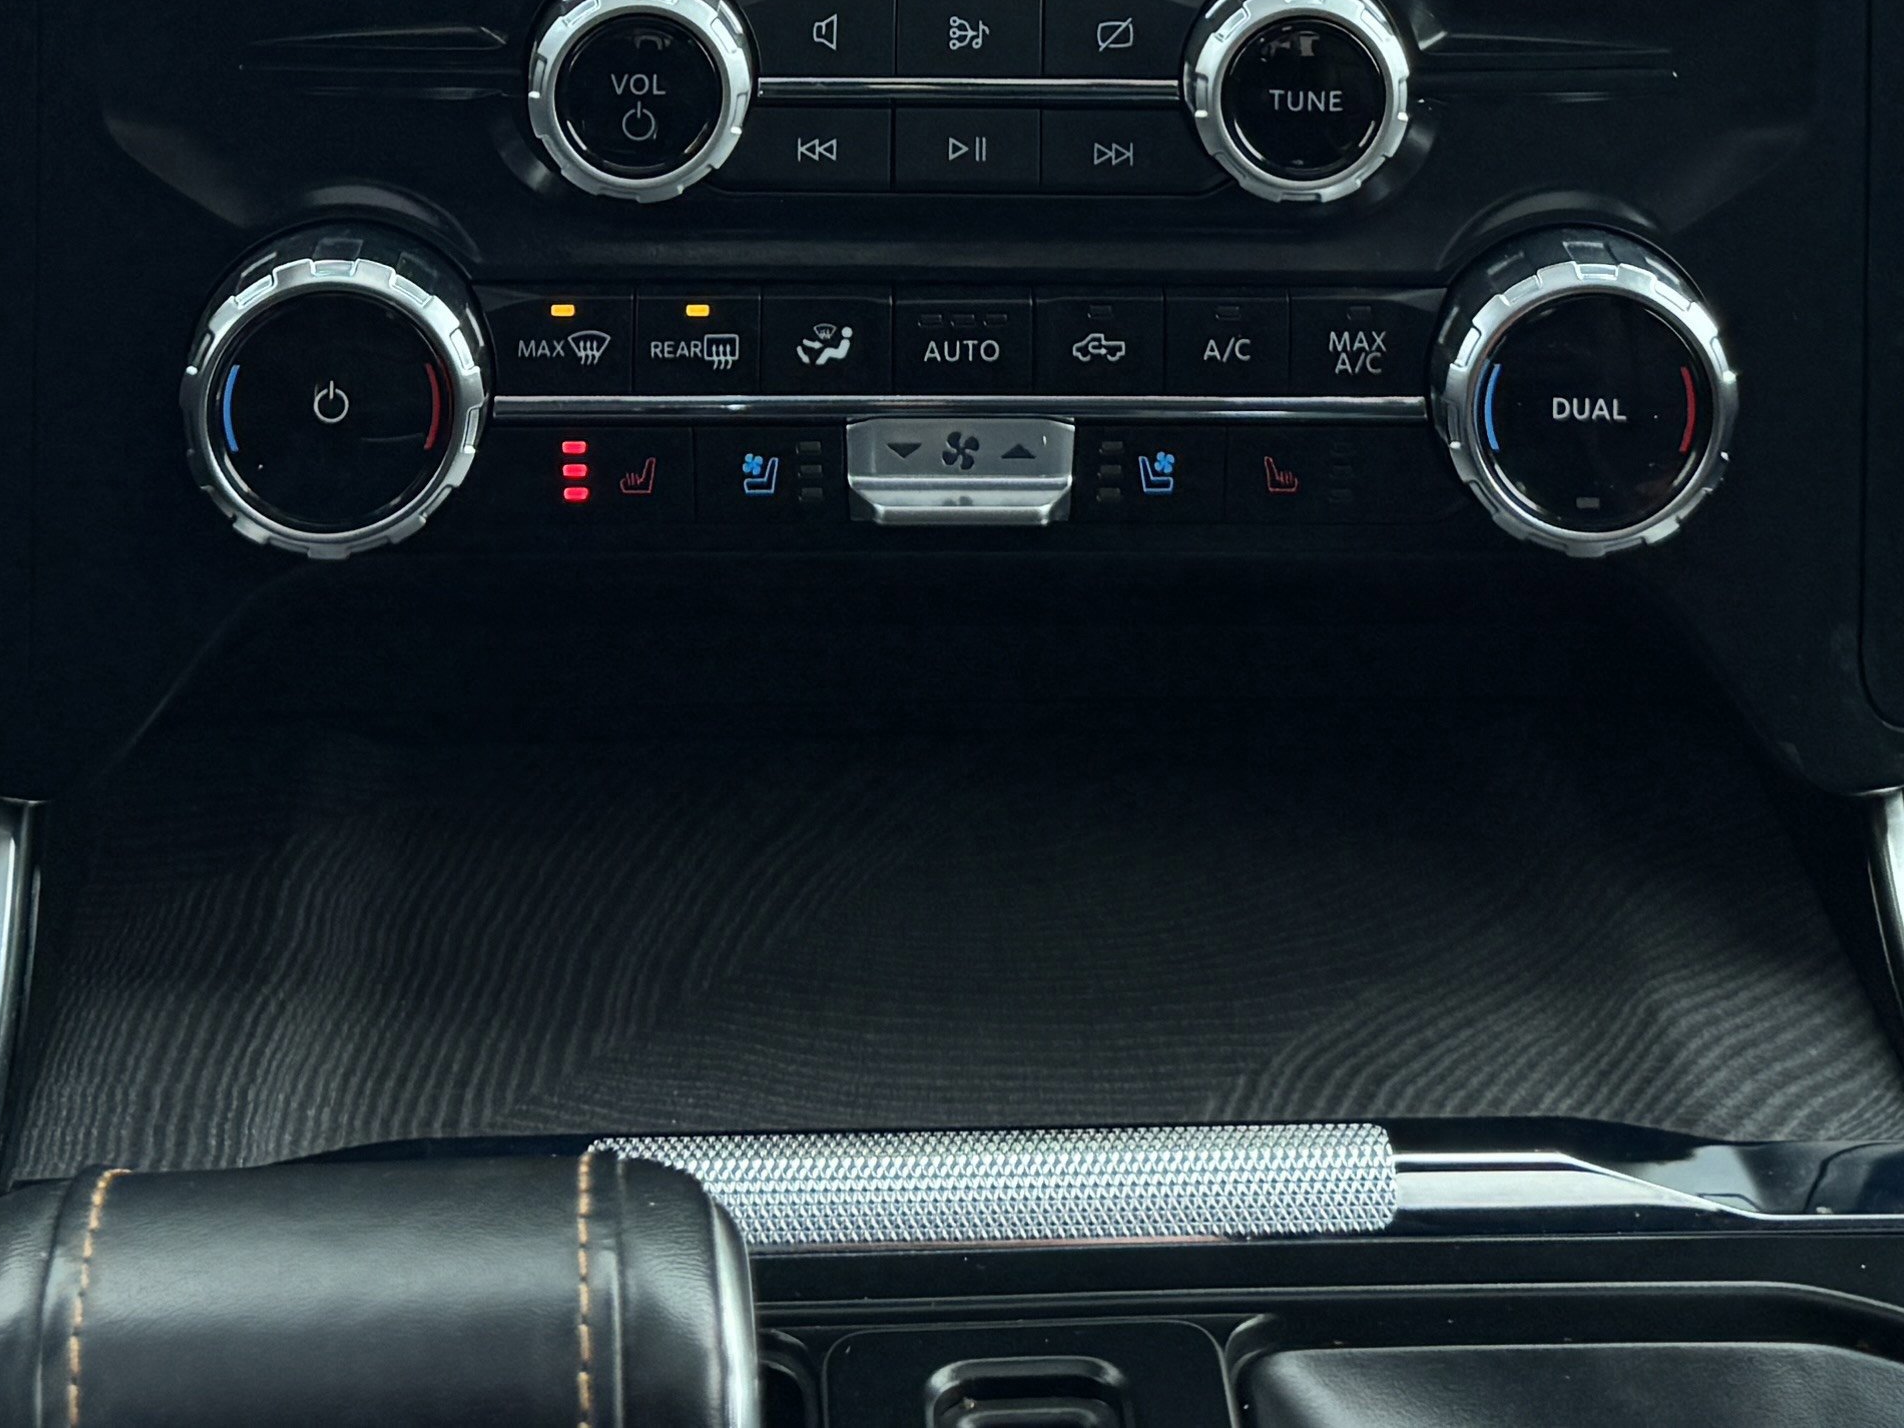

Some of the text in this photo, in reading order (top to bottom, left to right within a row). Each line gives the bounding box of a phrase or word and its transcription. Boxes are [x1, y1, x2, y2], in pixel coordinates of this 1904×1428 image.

[611, 74, 666, 97] VOL
[1269, 89, 1343, 113] TUNE
[518, 340, 565, 360] MAX
[650, 340, 702, 361] REAR
[923, 340, 1000, 363] AUTO
[1203, 339, 1251, 362] A/C
[1329, 331, 1387, 353] MAX
[1335, 352, 1382, 375] A/C
[1551, 398, 1627, 422] DUAL
